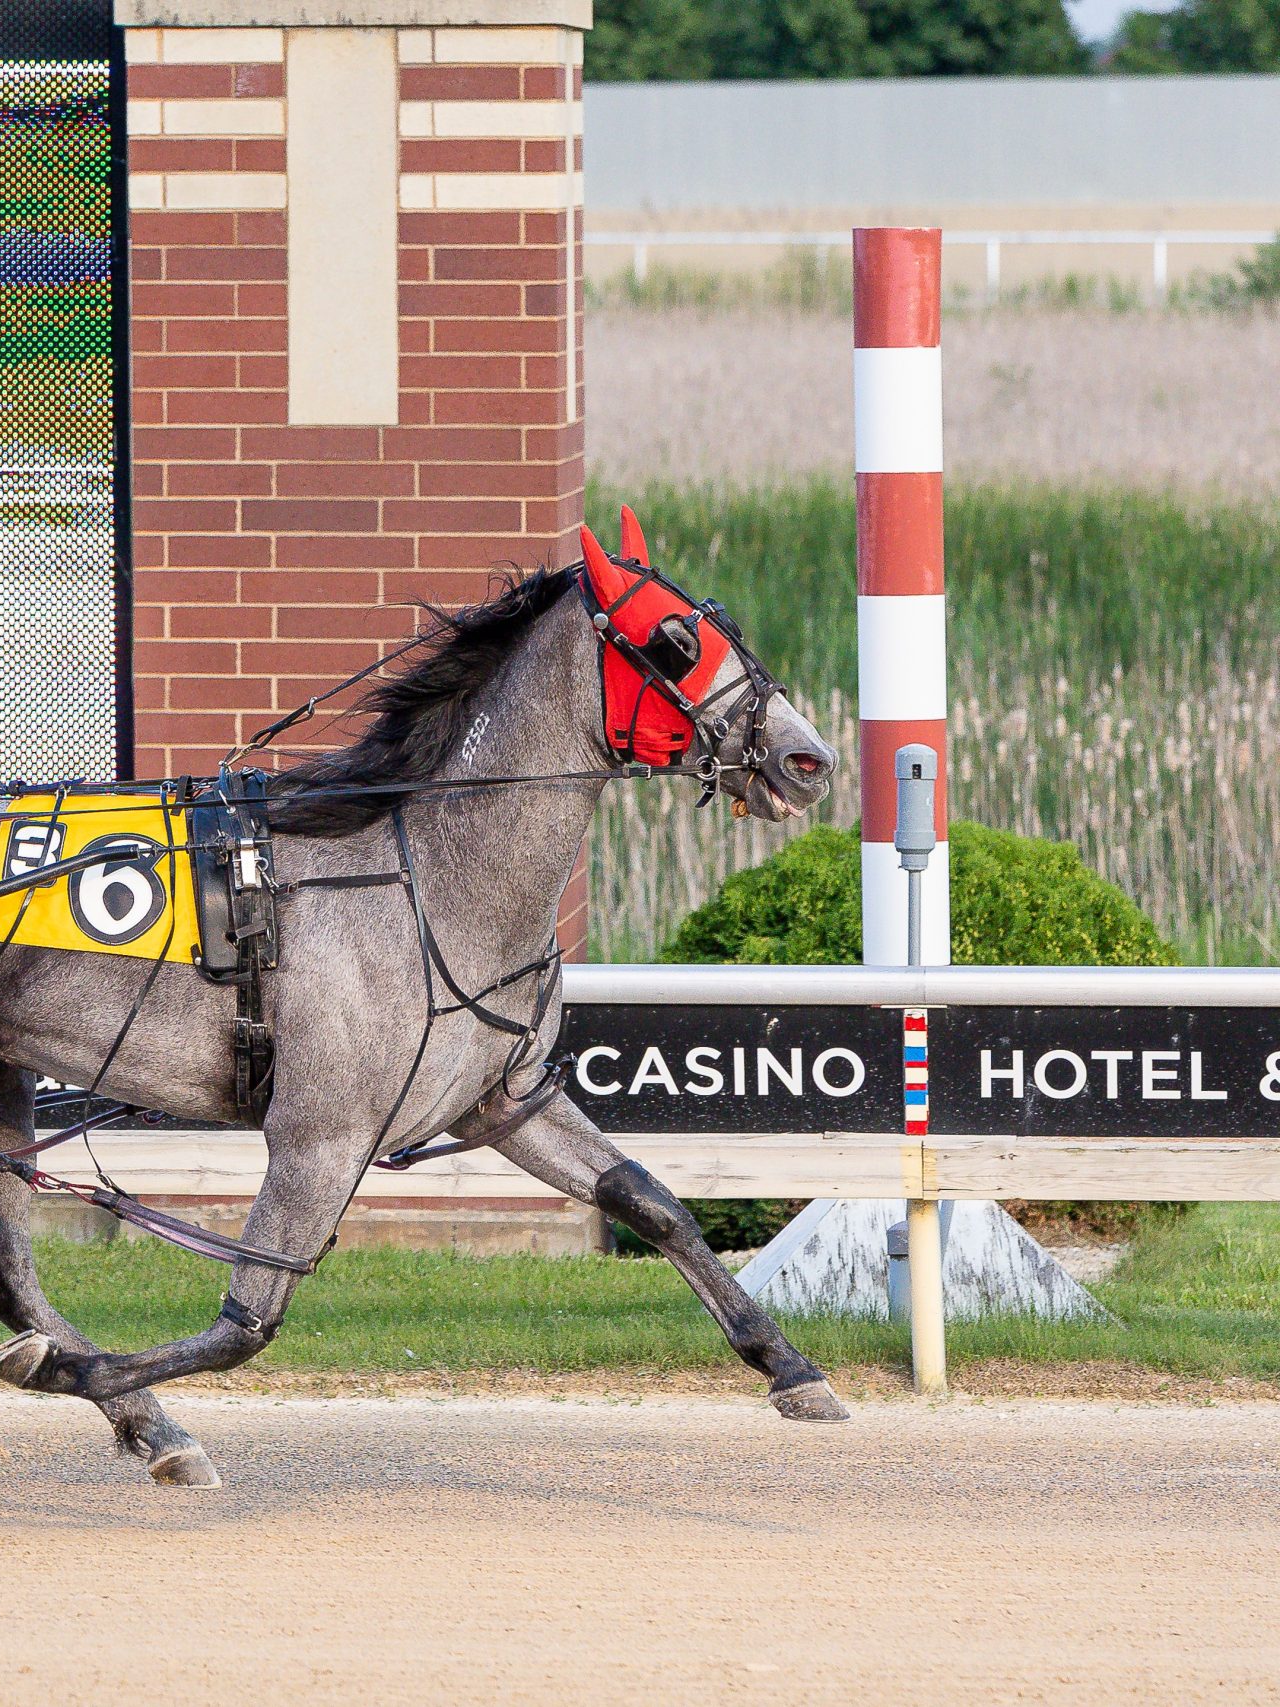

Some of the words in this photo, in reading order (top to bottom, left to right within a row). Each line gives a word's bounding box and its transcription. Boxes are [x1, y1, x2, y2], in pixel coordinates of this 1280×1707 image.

[75, 837, 158, 939] 6
[575, 1045, 866, 1097] CASINO
[980, 1049, 1228, 1100] HOTEL
